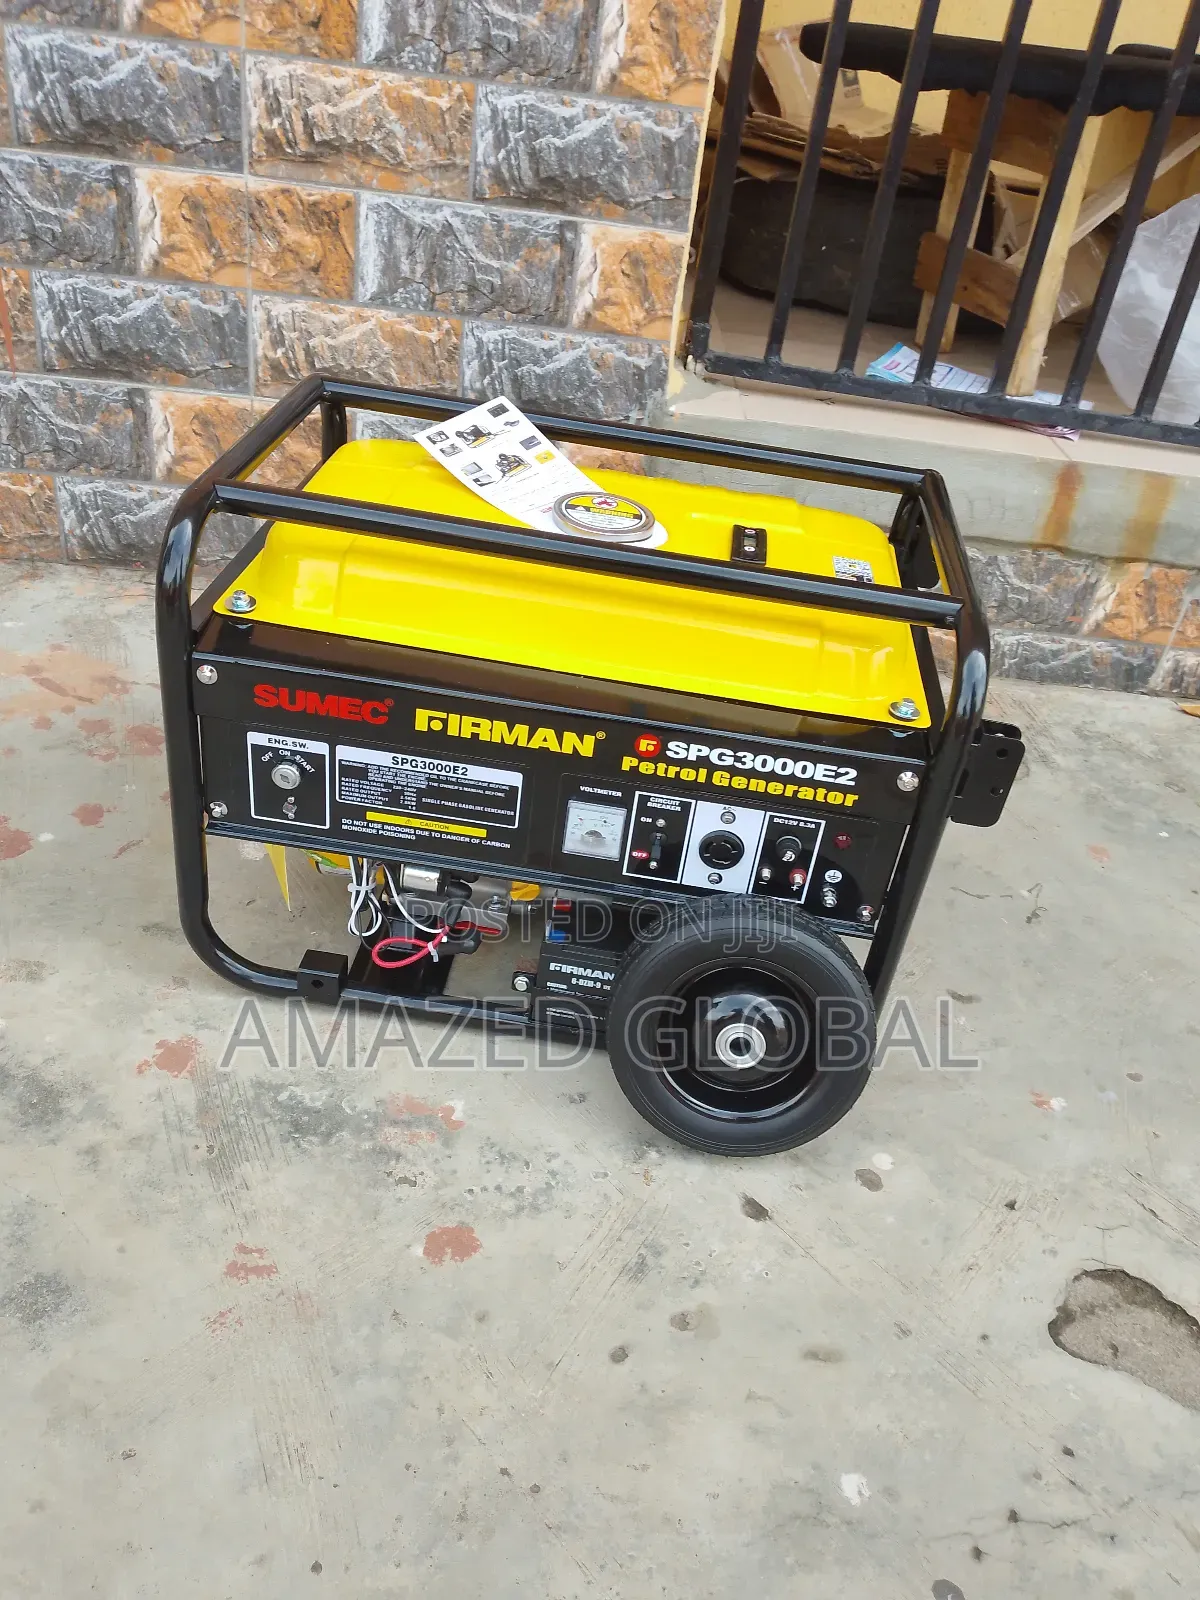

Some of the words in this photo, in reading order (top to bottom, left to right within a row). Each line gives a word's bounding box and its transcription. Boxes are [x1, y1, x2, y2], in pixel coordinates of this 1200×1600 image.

[267, 738, 309, 749] ENG.SW.
[261, 751, 274, 762] OFF
[294, 754, 316, 773] START
[392, 756, 468, 776] SPG3000E2
[665, 741, 858, 785] SPG3000E2
[621, 755, 707, 783] Petrol
[711, 770, 859, 807] Generator
[579, 785, 622, 797] VOLTMETER
[647, 801, 682, 812] BREAKER
[649, 796, 681, 806] CIRCUIT
[420, 821, 450, 830] CAUTION
[774, 817, 798, 826] DC12V
[341, 824, 378, 834] MONOXIDE
[378, 830, 416, 840] POISONING
[384, 825, 415, 834] INDOORS
[441, 833, 470, 842] DANGER
[481, 840, 511, 849] CARBON
[549, 963, 615, 981] FIRMAN
